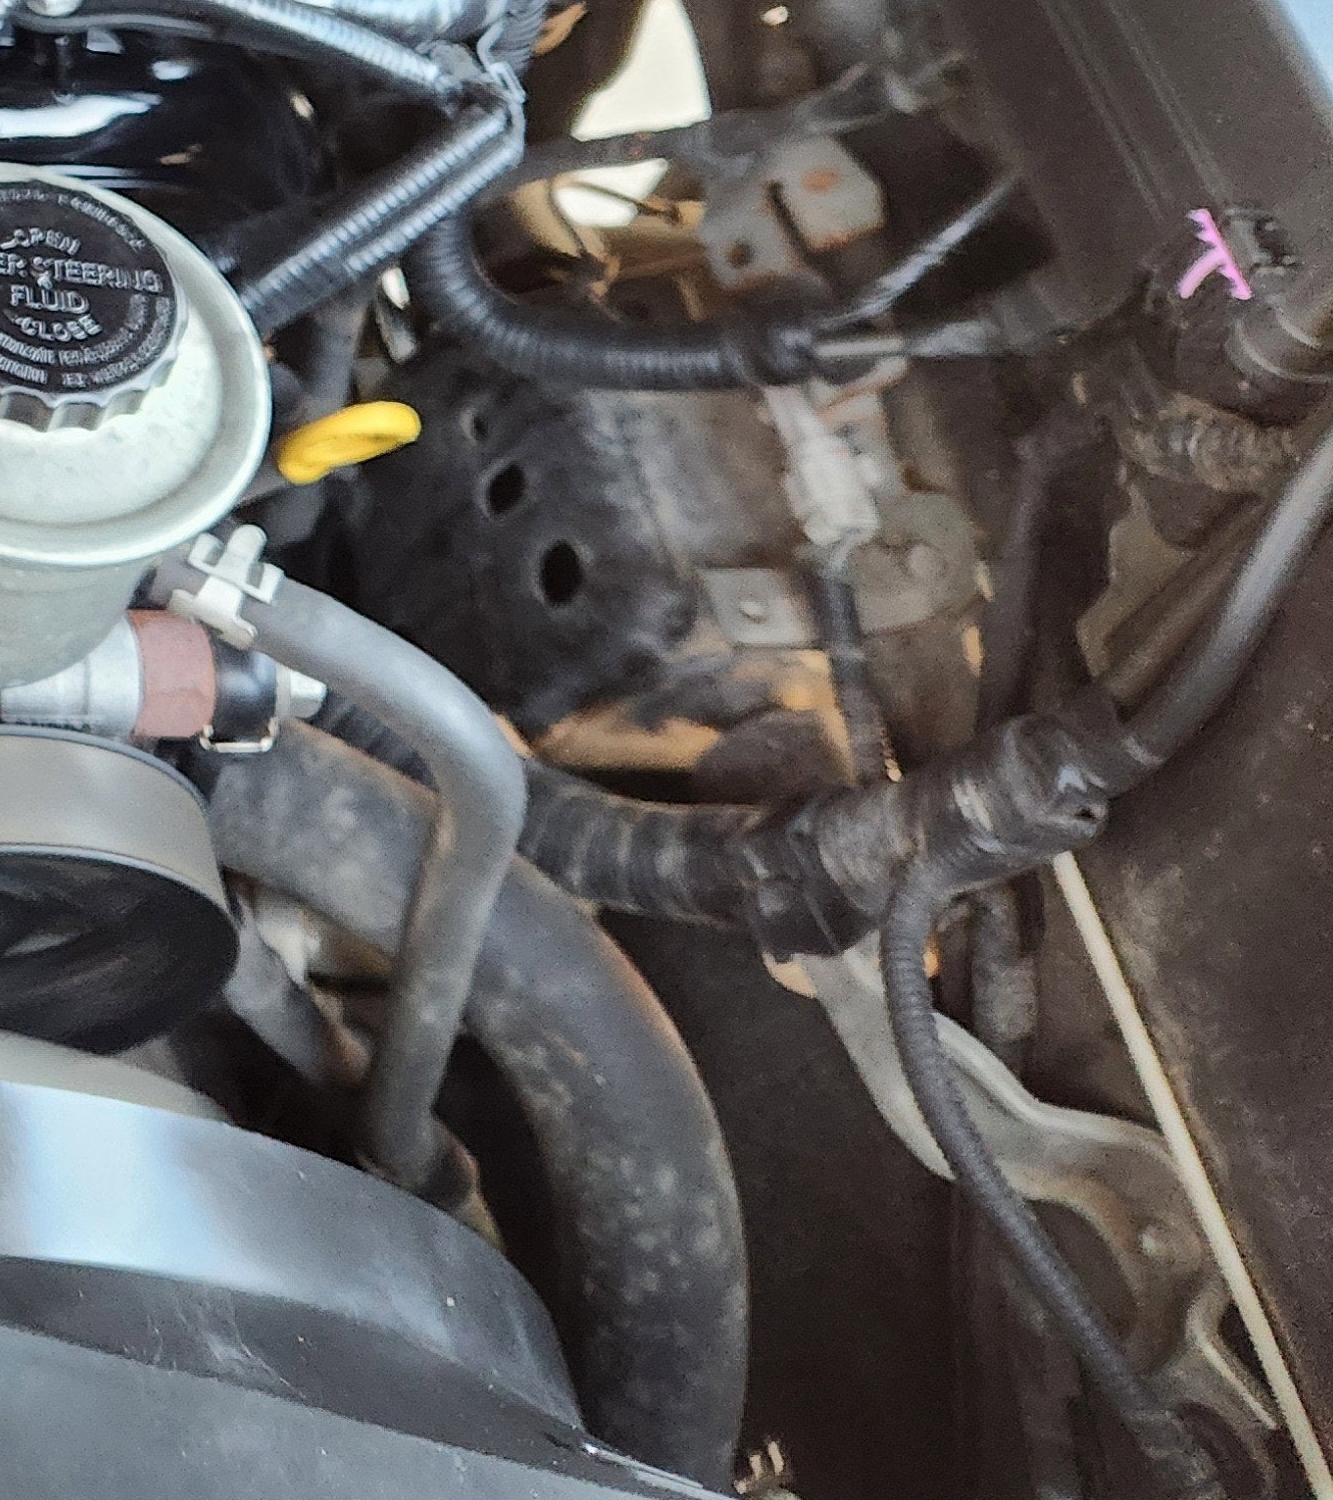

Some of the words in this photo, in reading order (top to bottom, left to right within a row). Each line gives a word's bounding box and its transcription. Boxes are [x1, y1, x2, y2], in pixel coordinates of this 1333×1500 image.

[13, 227, 81, 256] OPEN
[30, 255, 164, 293] STEERING
[10, 284, 90, 315] FLUID
[20, 313, 103, 342] CLOSE
